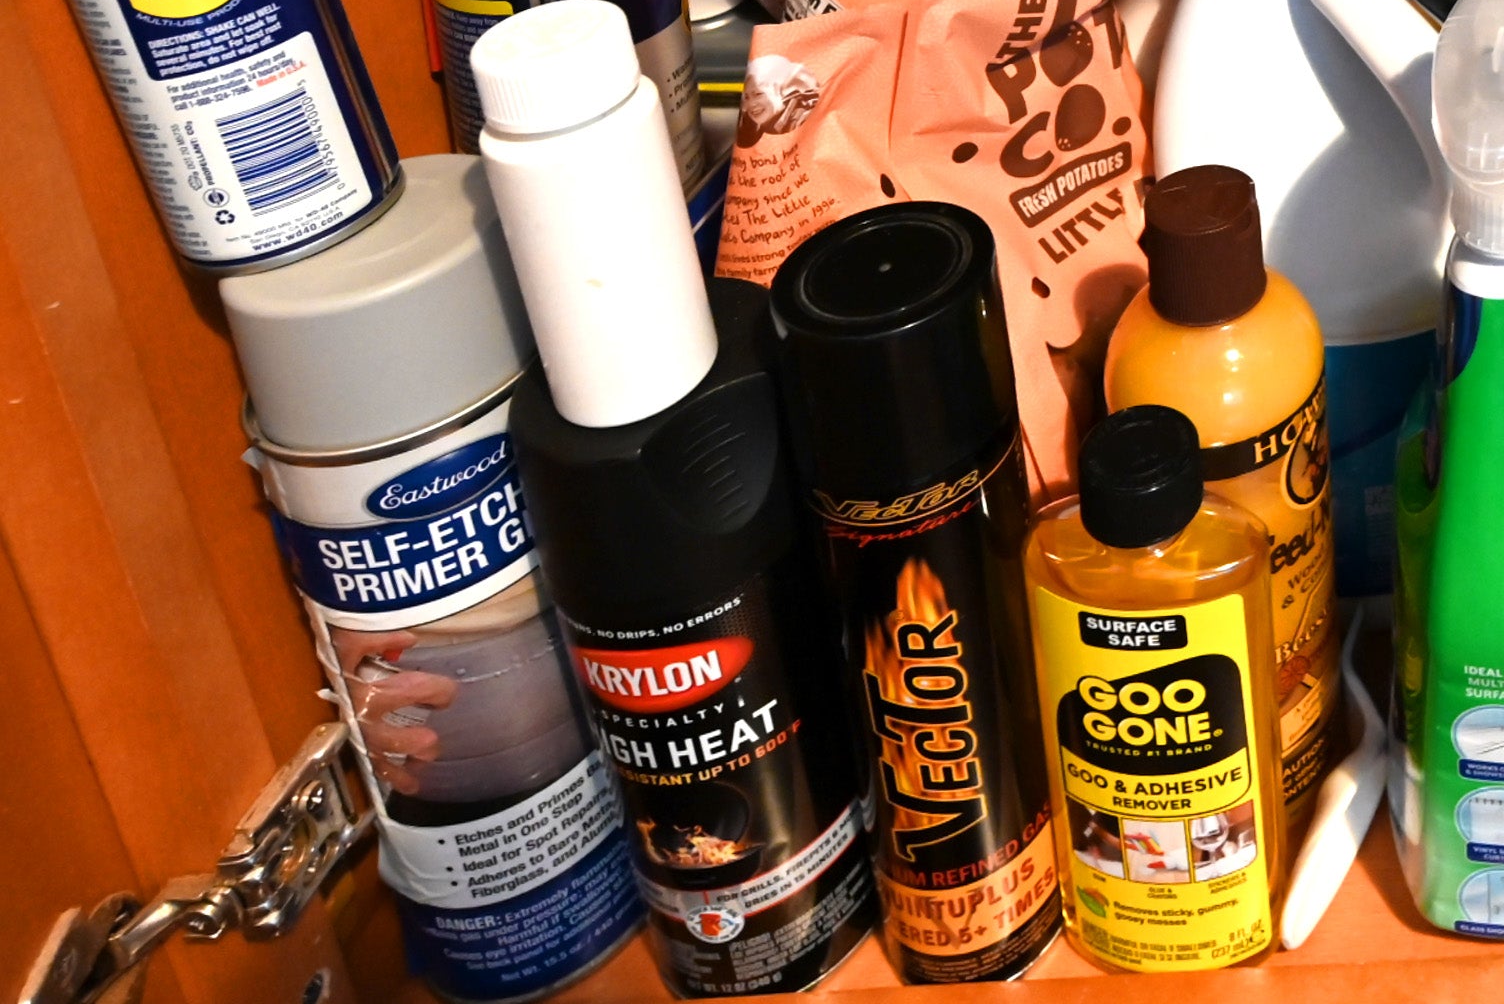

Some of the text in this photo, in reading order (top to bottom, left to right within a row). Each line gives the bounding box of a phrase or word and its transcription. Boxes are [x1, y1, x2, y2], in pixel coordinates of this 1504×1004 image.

[136, 12, 205, 27] MULTI-USE
[204, 11, 257, 36] SHAKE CAN
[213, 14, 279, 43] and for
[229, 30, 264, 48] For best
[167, 84, 180, 93] For
[181, 75, 219, 91] additional
[249, 58, 272, 71] safety
[272, 51, 286, 62] and
[221, 50, 237, 62] not
[171, 91, 199, 103] product
[201, 77, 246, 96] information
[174, 102, 189, 111] call
[738, 175, 756, 188] the
[789, 153, 801, 171] of
[1018, 152, 1125, 218] FRESH POTATOES
[763, 173, 810, 205] since we
[743, 209, 768, 226] The
[772, 196, 811, 219] Little
[252, 211, 344, 251] www.wd40.com
[740, 225, 795, 245] Company
[798, 218, 810, 228] in
[752, 249, 786, 263] strong
[380, 441, 507, 510] Eastwood
[332, 540, 490, 602] PRIMER
[597, 596, 742, 640] NO DRIPS, NO ERRORS
[1086, 617, 1177, 633] SURFACE
[1108, 634, 1160, 647] SAFE
[583, 649, 723, 697] KRYLON
[1464, 665, 1503, 678] IDEAL
[1078, 677, 1206, 715] GOO
[601, 702, 724, 728] SPECIALTY
[1083, 711, 1211, 746] GONE
[668, 698, 777, 769] HEAT
[863, 609, 988, 863] VECTOR
[1086, 740, 1140, 757] TRUSTED
[1166, 743, 1213, 757] BRAND
[698, 764, 723, 781] UP
[728, 753, 751, 771] TO
[1067, 763, 1243, 796] GOO & ADHESIVE
[1467, 763, 1498, 771] WORKS
[455, 775, 585, 846] Etches and Primes
[1112, 796, 1192, 811] REMOVER
[459, 791, 583, 857] Metal in One Step
[462, 855, 498, 873] Ideal
[501, 845, 523, 862] for
[525, 828, 560, 851] Spot
[467, 861, 527, 887] Adheres
[529, 851, 545, 865] to
[548, 831, 580, 857] Bare
[932, 839, 1020, 886] REFINED
[1473, 846, 1498, 854] VINYL
[471, 867, 549, 898] Fiberglass,
[552, 847, 579, 868] and
[717, 836, 832, 903] FOR GRILLS, FIREPITS
[745, 833, 849, 909] DRIES IN 15 MINUTES
[436, 886, 569, 931] DANGER: Extremely
[483, 922, 519, 940] under
[584, 870, 609, 894] may
[958, 866, 1054, 944] 5+ TIMES
[1113, 898, 1239, 917] Removes sticky, gummy,
[1147, 916, 1187, 926] messes
[484, 924, 568, 960] eye irritation.
[497, 913, 561, 946] Harmful if
[514, 946, 544, 966] panel
[545, 938, 561, 951] for
[501, 970, 520, 982] Net
